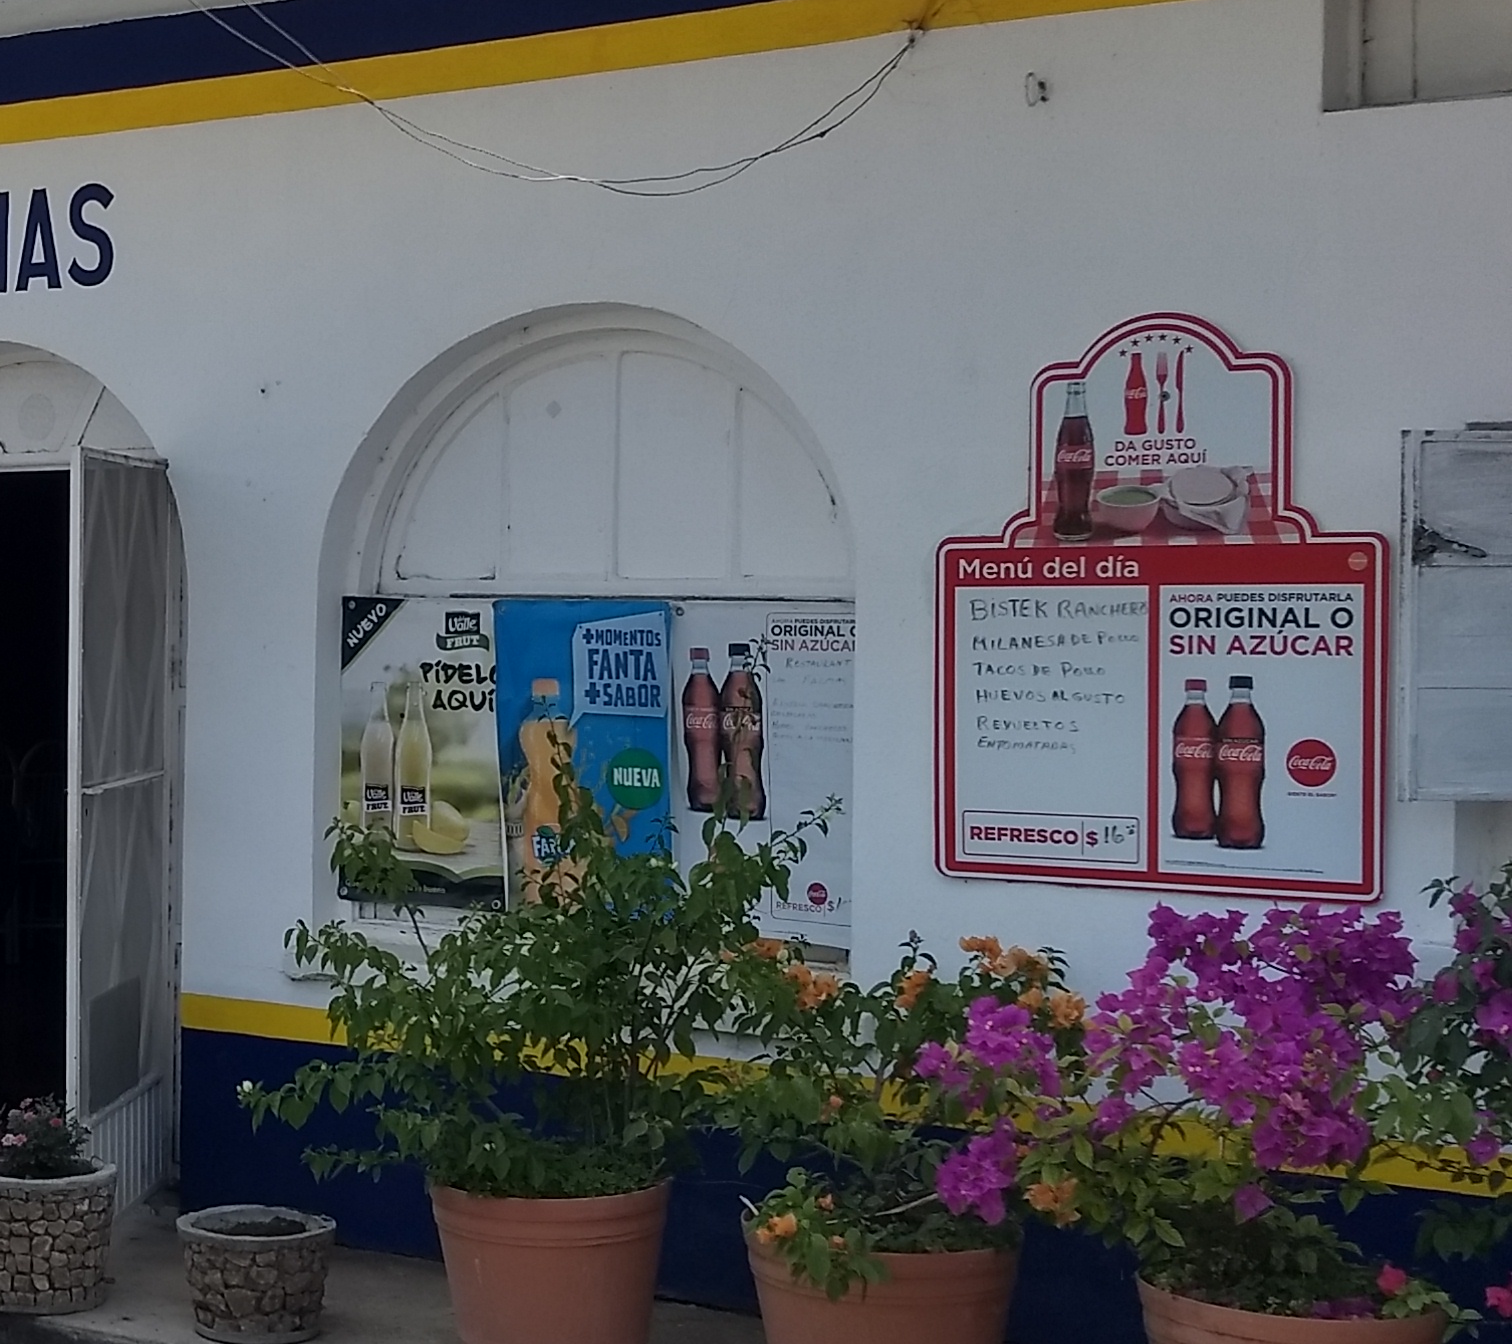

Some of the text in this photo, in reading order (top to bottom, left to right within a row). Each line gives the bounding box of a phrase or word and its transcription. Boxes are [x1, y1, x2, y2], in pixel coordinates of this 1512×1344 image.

[1115, 438, 1196, 452] DA GUSTO
[1104, 449, 1207, 466] COMER AQUÍ
[958, 555, 1139, 579] Menú del día
[1169, 592, 1354, 603] AHORA PUEDES DISFRUTARLA
[346, 603, 387, 647] NUEVO
[449, 617, 478, 632] Valle
[1169, 607, 1354, 628] ORIGINAL O
[771, 625, 845, 637] ORIGINAL
[446, 635, 480, 648] FRUT
[771, 639, 795, 651] SIN
[1169, 630, 1354, 656] SIN AZÚCAR
[588, 649, 657, 681] FANTA
[432, 689, 496, 712] AQUÍ
[613, 767, 661, 787] NUEVA
[970, 826, 1078, 845] REFRESCO
[1086, 831, 1098, 847] $
[776, 901, 822, 913] REFRESCO
